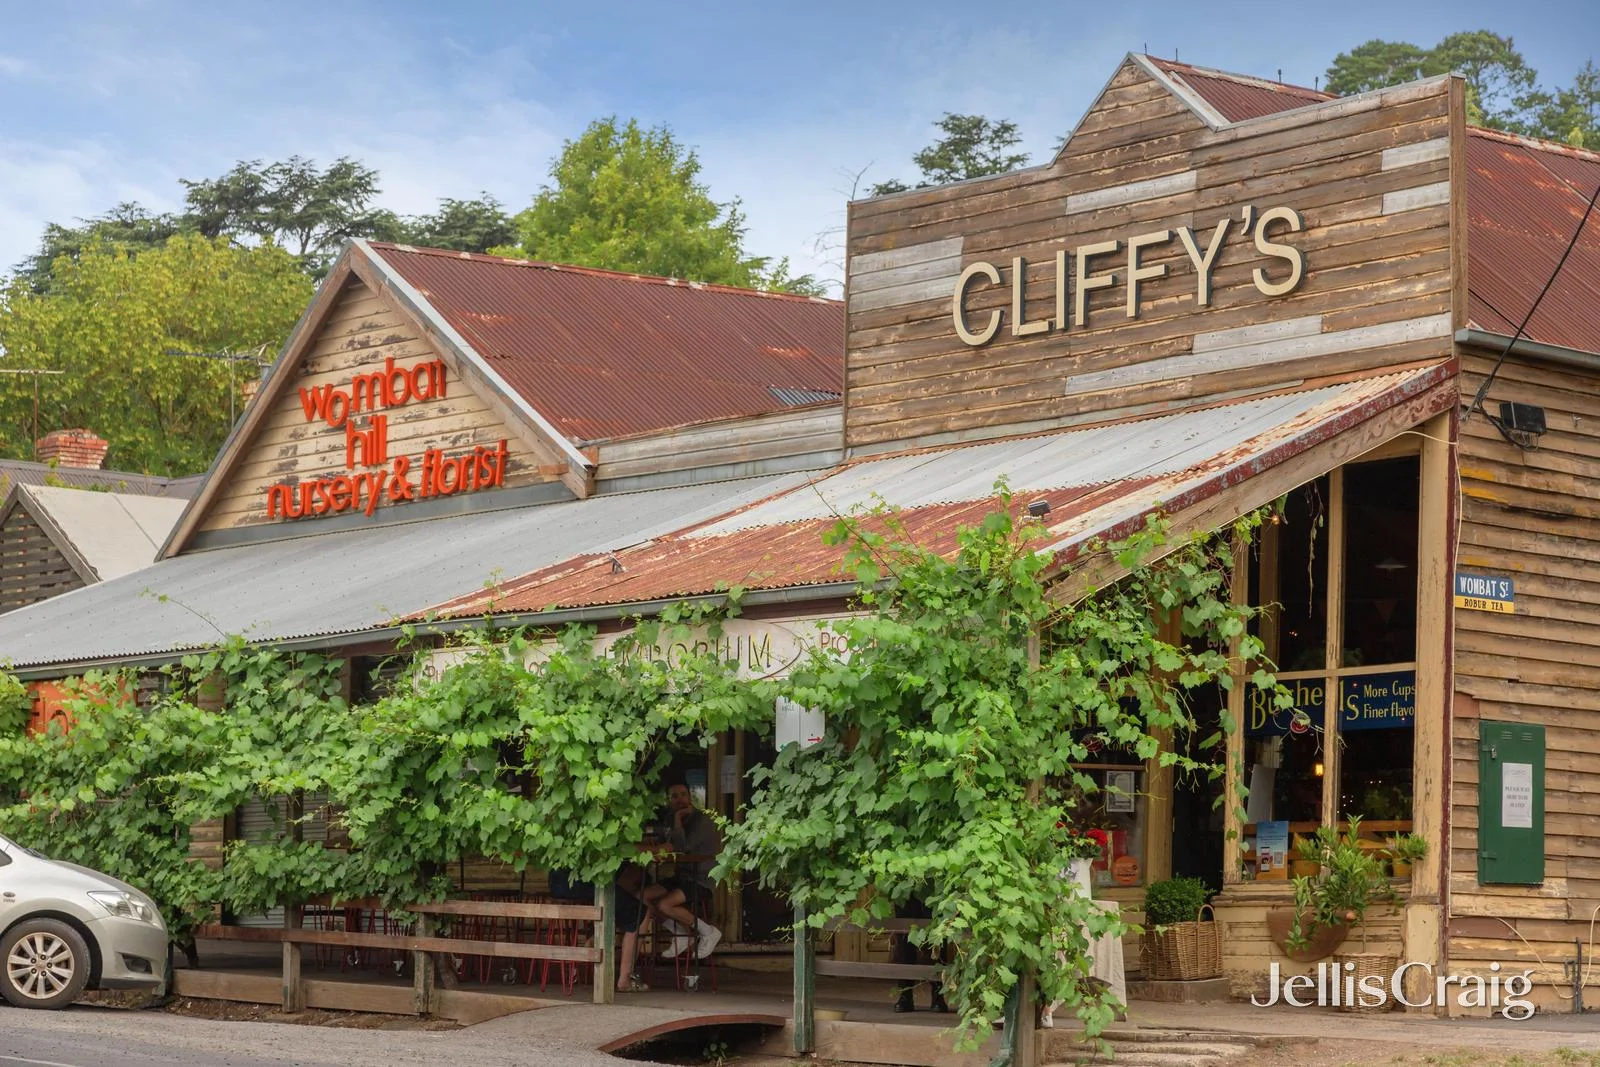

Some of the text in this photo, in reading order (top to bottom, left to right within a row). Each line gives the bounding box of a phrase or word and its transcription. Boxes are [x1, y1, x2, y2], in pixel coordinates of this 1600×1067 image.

[952, 205, 1304, 346] CLIFFY'S
[298, 356, 447, 427] wombat
[346, 414, 387, 470] hill
[267, 439, 510, 519] nursery & florist
[1460, 576, 1497, 597] WOMBAT
[1464, 598, 1504, 611] ROBUR TEA
[1363, 680, 1416, 701] More Cups
[1363, 703, 1388, 719] Finer
